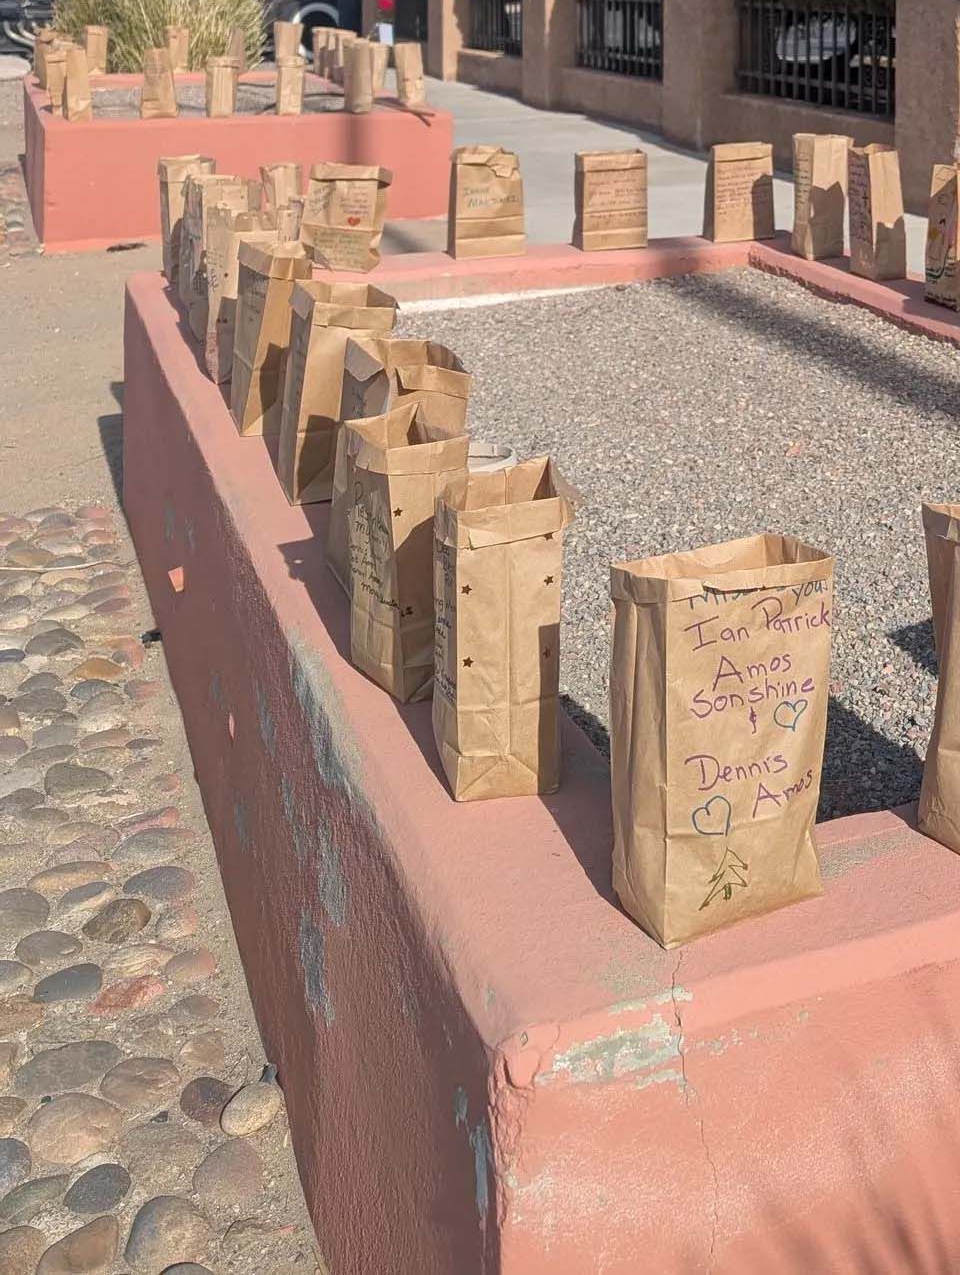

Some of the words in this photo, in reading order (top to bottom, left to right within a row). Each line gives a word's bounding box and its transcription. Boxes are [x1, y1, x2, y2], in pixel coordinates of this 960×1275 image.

[683, 615, 750, 652] Ian
[751, 596, 831, 635] Patrick
[712, 653, 792, 692] Amos
[689, 677, 816, 719] Sonshine
[684, 754, 789, 791] Dennis
